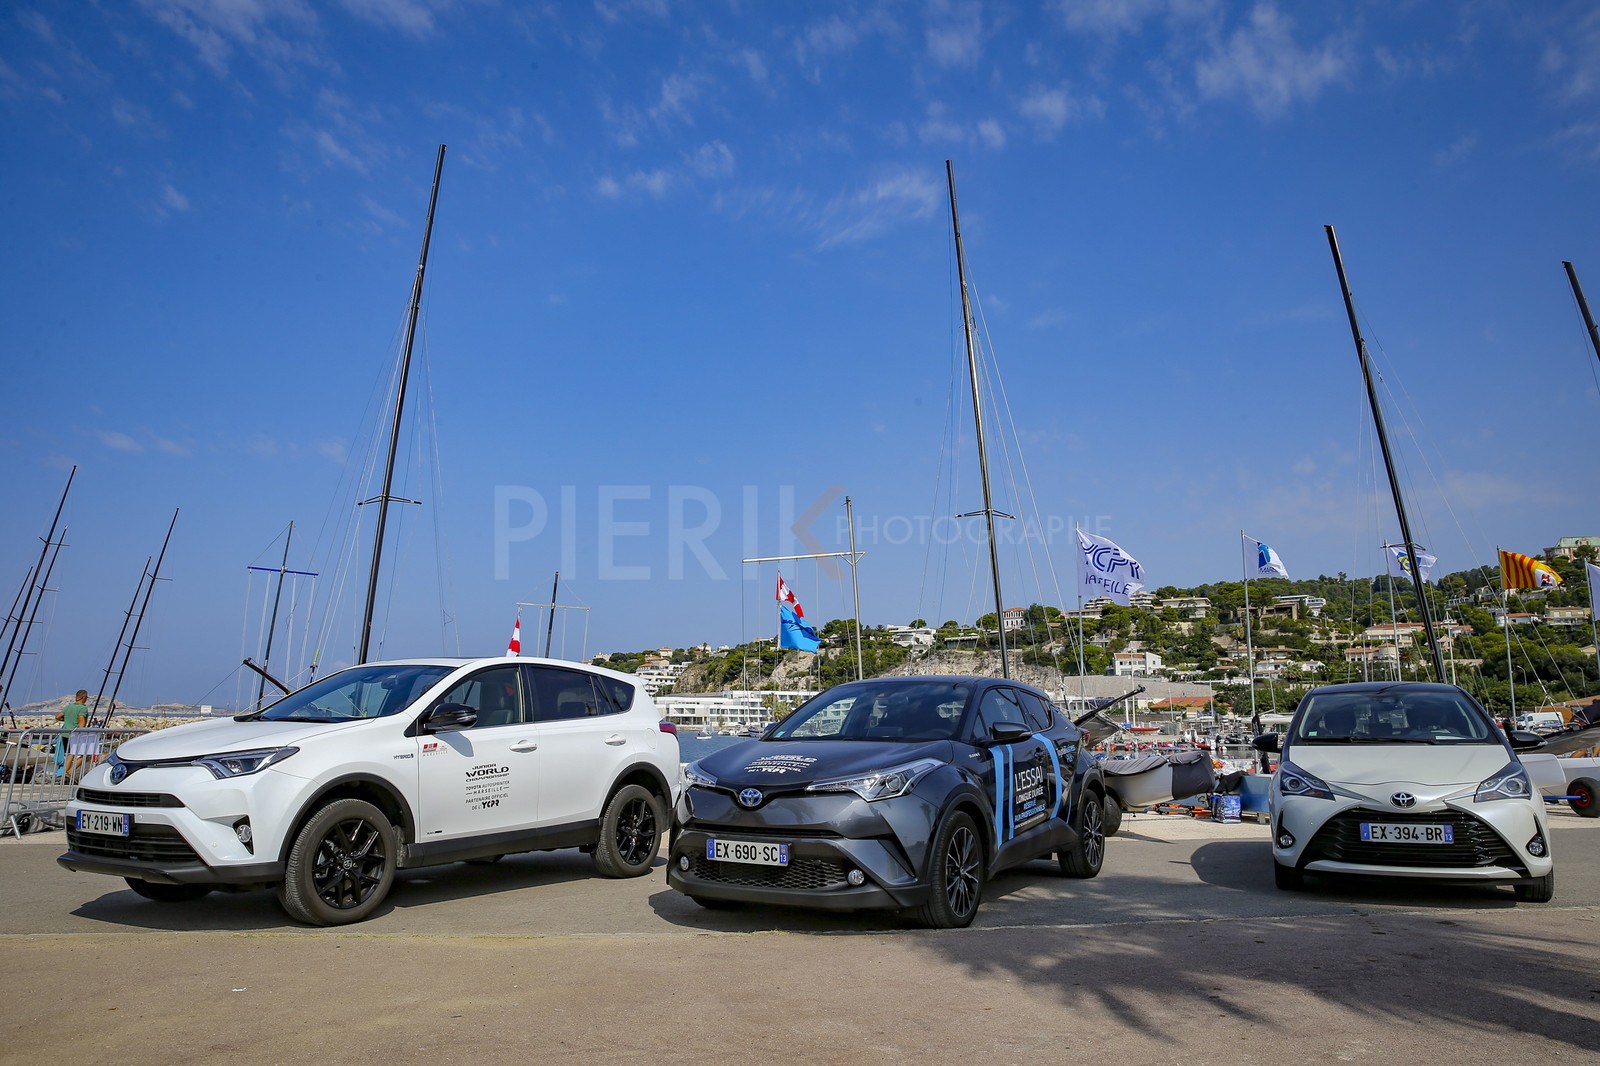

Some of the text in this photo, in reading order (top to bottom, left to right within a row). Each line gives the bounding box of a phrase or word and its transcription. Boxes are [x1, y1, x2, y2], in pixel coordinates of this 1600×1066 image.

[466, 767, 509, 777] WORLD
[1015, 766, 1043, 791] L'ESSAI
[82, 814, 123, 832] EY-219-WN
[1371, 826, 1443, 841] EX-394-BR
[716, 843, 778, 862] EX-690-SC
